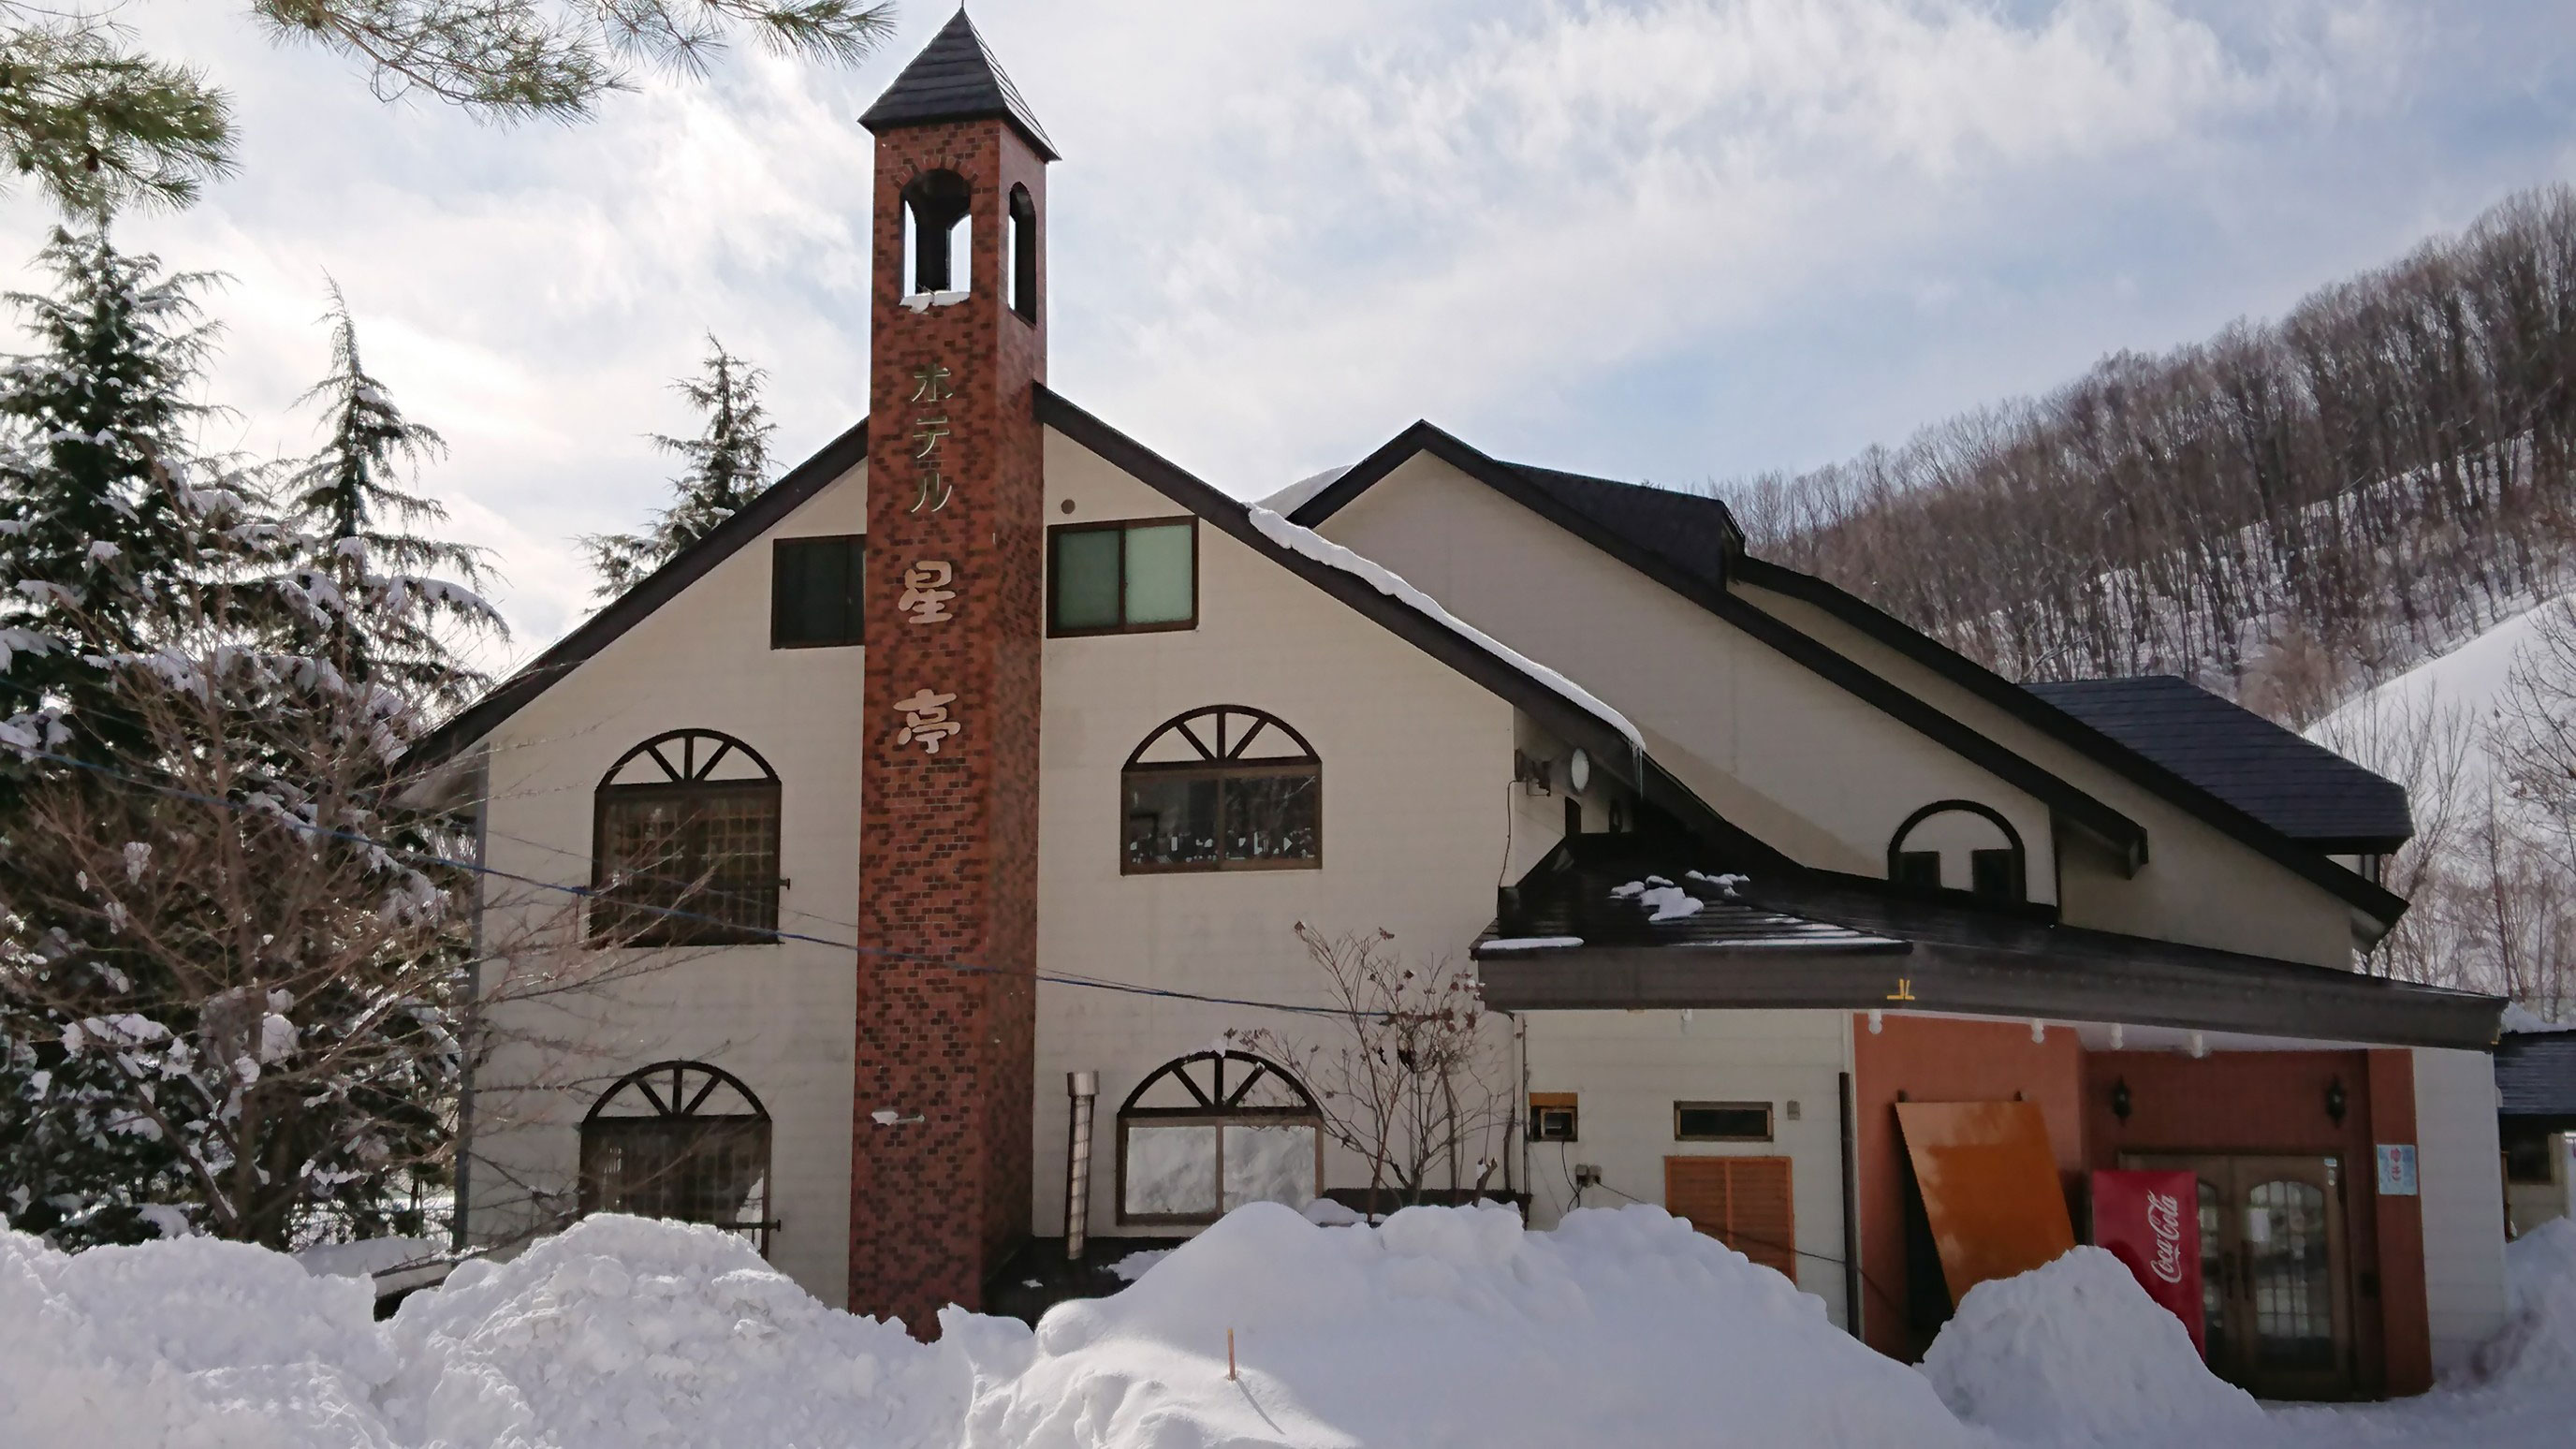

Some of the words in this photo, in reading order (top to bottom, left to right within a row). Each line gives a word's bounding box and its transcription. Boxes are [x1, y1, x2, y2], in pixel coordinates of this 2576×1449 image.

[911, 364, 953, 513] ホテル
[893, 561, 960, 754] 星亭
